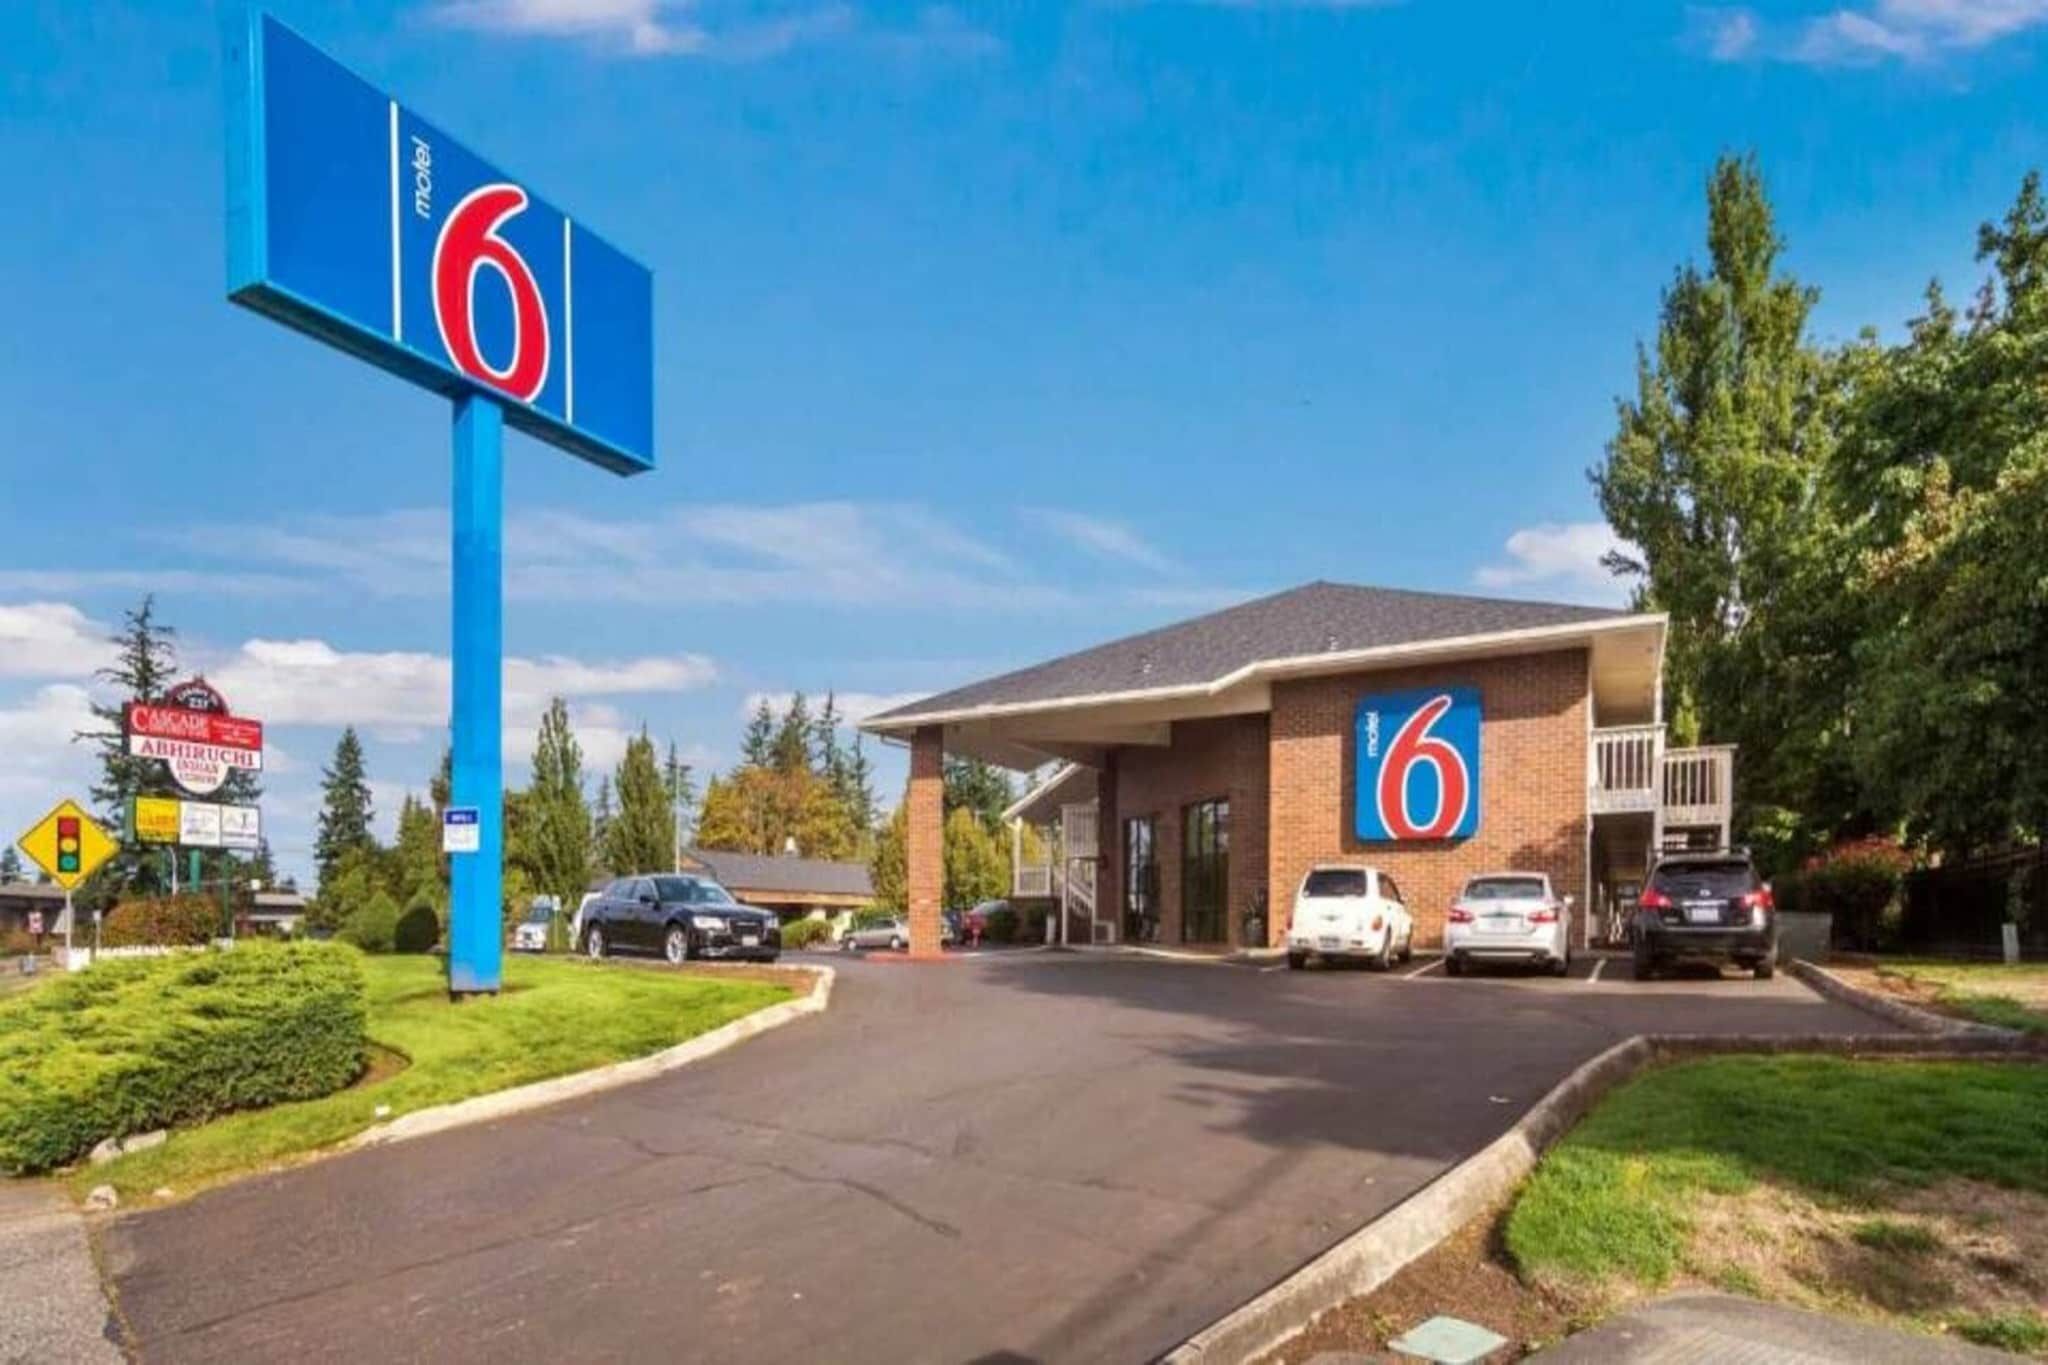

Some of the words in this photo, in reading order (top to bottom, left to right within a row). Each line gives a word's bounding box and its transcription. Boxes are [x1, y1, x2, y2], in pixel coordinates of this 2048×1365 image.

[411, 136, 431, 219] motel
[432, 183, 551, 404] 6
[140, 739, 254, 766] ABHIRUCHI
[1364, 711, 1379, 757] motel
[1376, 694, 1470, 840] 6
